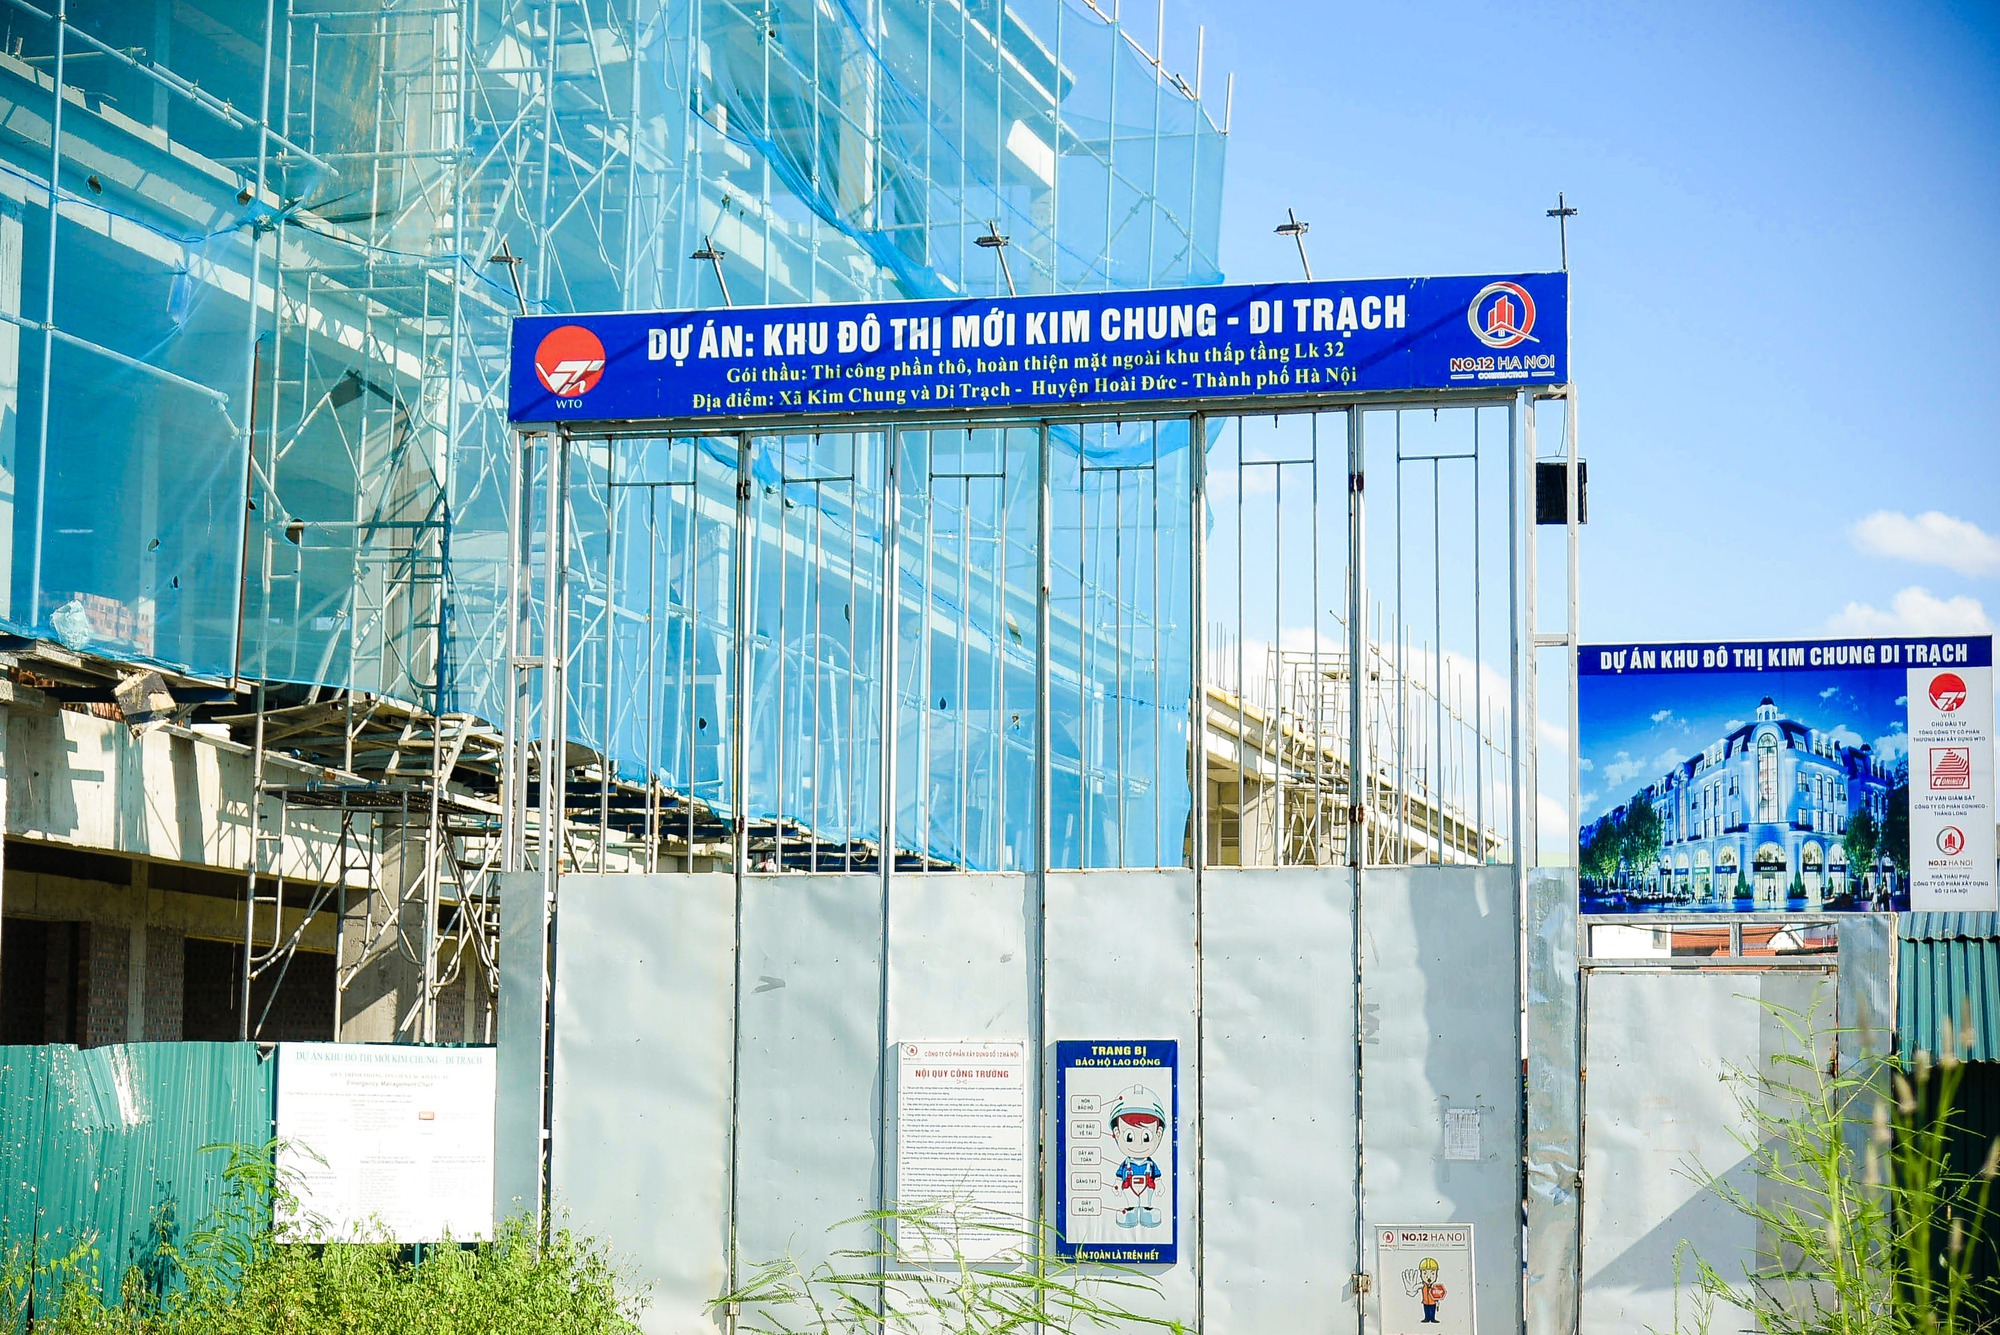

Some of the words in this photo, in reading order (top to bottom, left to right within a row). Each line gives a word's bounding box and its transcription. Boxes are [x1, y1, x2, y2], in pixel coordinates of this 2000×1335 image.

[647, 324, 694, 367] DỰ
[698, 319, 754, 359] ÁN:
[763, 321, 829, 357] KHU
[836, 312, 881, 354] ĐÔ
[889, 316, 942, 357] THỊ
[951, 307, 1016, 349] MỚI
[1025, 309, 1091, 346] KIM
[1100, 302, 1217, 341] CHUNG
[1227, 317, 1239, 326] -
[1249, 299, 1283, 335] DI
[1292, 294, 1406, 339] TRẠCH
[726, 367, 757, 385] Gói
[761, 362, 808, 382] thầu:
[811, 364, 841, 381] Thi
[845, 363, 886, 382] công
[890, 356, 933, 382] phần
[938, 359, 972, 377] thô,
[976, 356, 1019, 374] hoàn
[1023, 354, 1069, 375] thiện
[1073, 352, 1108, 372] mặt
[1112, 347, 1161, 370] ngoài
[1166, 348, 1199, 366] khu
[1204, 342, 1245, 366] thấp
[1250, 340, 1290, 363] tầng
[1294, 342, 1319, 359] Lk
[1324, 341, 1345, 358] 32
[1450, 357, 1495, 373] NO.12
[1497, 355, 1522, 370] HA
[1524, 354, 1555, 370] NOI
[691, 393, 721, 412] Địa
[726, 388, 774, 408] điểm:
[779, 390, 803, 406] Xã
[807, 389, 845, 405] Kim
[848, 387, 907, 405] Chung
[911, 384, 930, 400] và
[935, 383, 955, 400] Di
[959, 381, 1011, 402] Trạch
[1031, 378, 1089, 398] Huyện
[1094, 374, 1136, 393] Hoài
[1141, 373, 1177, 391] Đức
[1193, 369, 1251, 389] Thành
[1256, 365, 1290, 389] phố
[1295, 367, 1321, 384] Hà
[1326, 366, 1357, 386] Nội
[555, 399, 583, 409] WTO
[1600, 649, 1628, 674] DỰ
[1630, 647, 1656, 669] ÁN
[1660, 649, 1699, 669] KHU
[1702, 645, 1728, 668] ĐÔ
[1732, 648, 1763, 671] THỊ
[1767, 647, 1805, 667] KIM
[1809, 645, 1876, 667] CHUNG
[1880, 644, 1900, 664] DI
[1904, 643, 1968, 667] TRẠCH
[1091, 1045, 1132, 1056] TRANG
[1134, 1045, 1147, 1057] BỊ
[1075, 1056, 1095, 1067] BẢO
[1097, 1057, 1111, 1067] HỘ
[1113, 1058, 1131, 1067] LAO
[1132, 1057, 1161, 1067] ĐỘNG
[915, 1068, 930, 1079] NỘI
[932, 1069, 949, 1078] QUY
[950, 1068, 973, 1078] CÔNG
[975, 1068, 1009, 1078] TRƯỜNG
[1401, 1233, 1428, 1242] NO.12
[1430, 1233, 1444, 1242] HA
[1446, 1233, 1466, 1242] NOI
[1089, 1249, 1110, 1261] TOÀN
[1111, 1249, 1122, 1260] LÀ
[1122, 1249, 1143, 1261] TRÊN
[1144, 1248, 1160, 1261] HẾT
